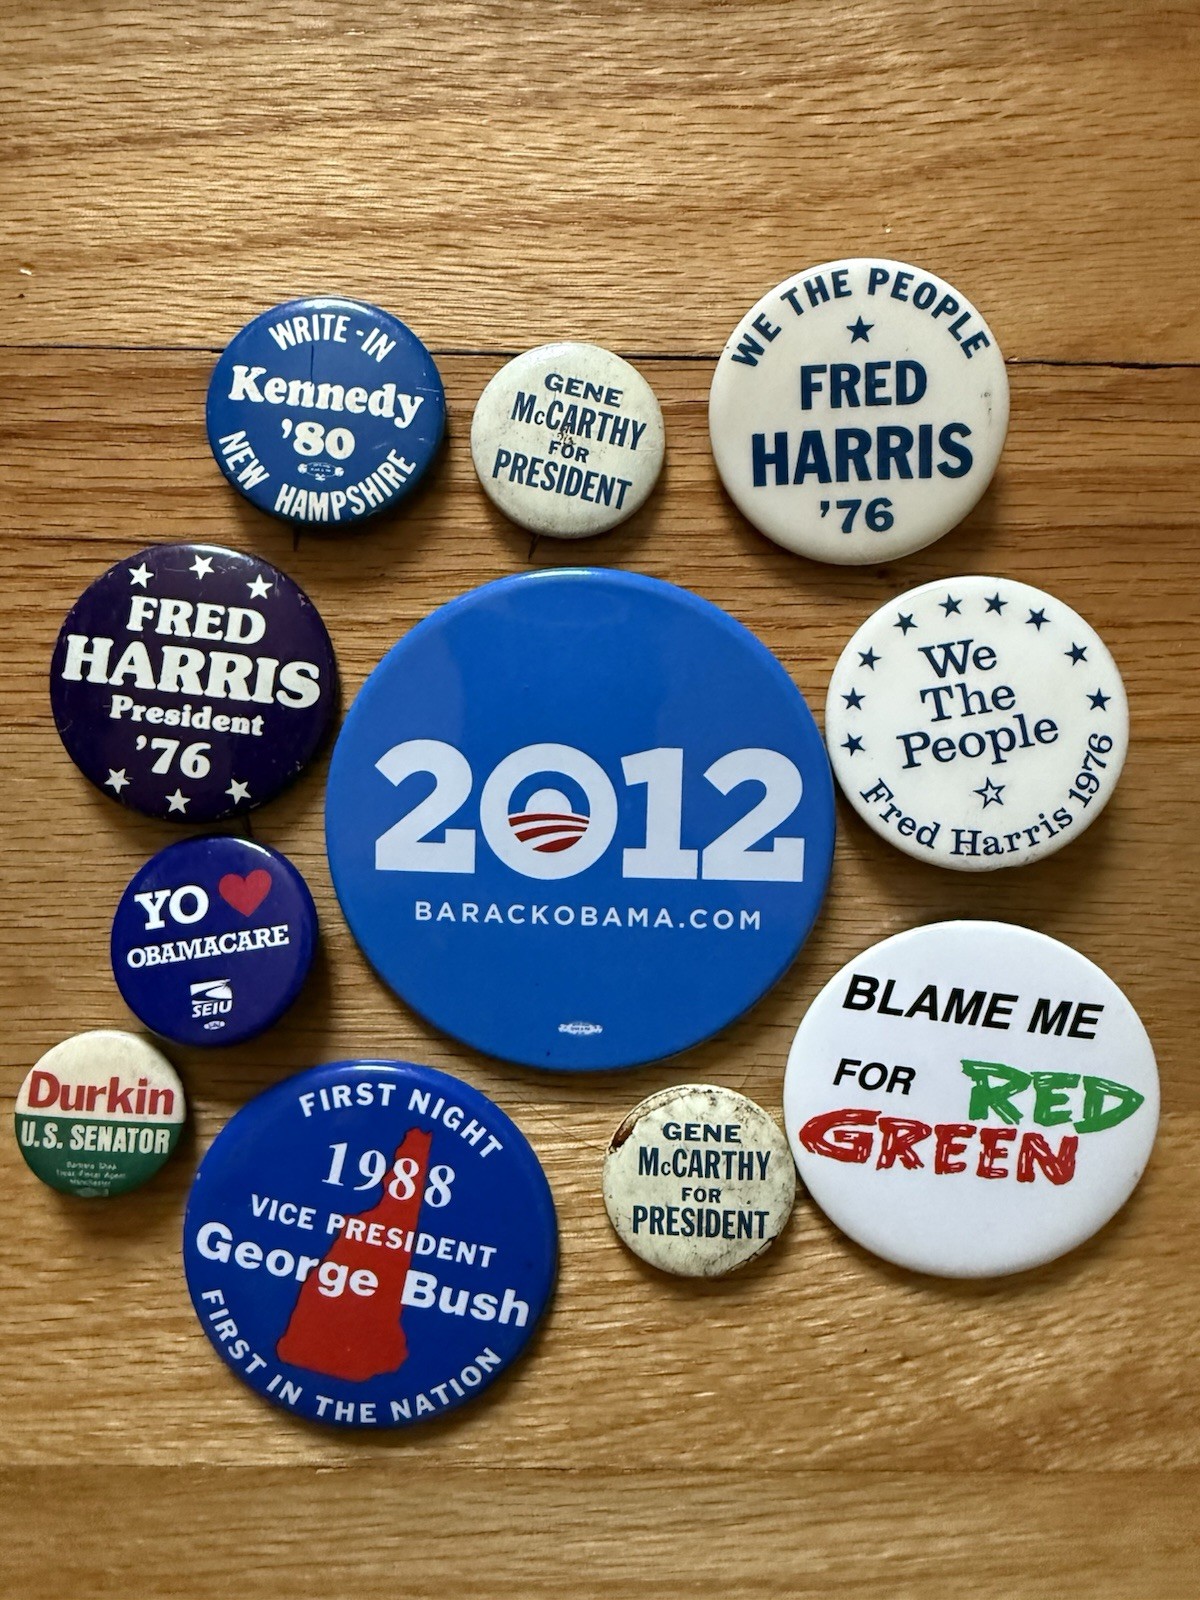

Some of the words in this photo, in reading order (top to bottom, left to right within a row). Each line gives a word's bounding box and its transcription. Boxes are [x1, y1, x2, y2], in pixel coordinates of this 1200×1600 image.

[731, 313, 782, 367] WE
[781, 269, 851, 316] THE
[868, 267, 990, 359] PEOPLE
[228, 364, 424, 429] Kennedy
[545, 373, 624, 408] GENE
[800, 360, 928, 410] FRED
[280, 418, 356, 461] '80
[511, 391, 647, 451] McCARTHY
[219, 430, 270, 491] NEW
[274, 449, 416, 522] HAMPSHIRE
[548, 440, 590, 464] FOR
[752, 422, 973, 487] HARRIS
[492, 449, 633, 510] PRESIDENT
[820, 497, 894, 534] '76
[126, 595, 266, 644] FRED
[61, 634, 321, 709] HARRIS
[917, 639, 997, 679] We
[109, 694, 264, 736] President
[919, 683, 1016, 722] The
[136, 734, 211, 779] '76
[896, 713, 1059, 770] People
[374, 739, 805, 882] 2012
[859, 778, 941, 850] Fred
[950, 806, 1073, 857] Harris
[1068, 733, 1114, 809] 1976
[134, 884, 210, 931] YO
[415, 900, 761, 931] BARACKOBAMA.COM
[126, 924, 290, 969] OBAMACARE
[191, 999, 233, 1018] SEIU
[842, 974, 1018, 1030] BLAME
[1027, 999, 1105, 1040] ME
[27, 1070, 175, 1115] Durkin
[833, 1058, 917, 1095] FOR
[960, 1059, 1146, 1134] RED
[20, 1120, 64, 1150] U.S.
[69, 1124, 171, 1154] SENATOR
[298, 1082, 397, 1118] FIRST
[407, 1088, 503, 1159] NIGHT
[662, 1122, 742, 1144] GENE
[638, 1147, 771, 1182] McCARTHY
[799, 1108, 1079, 1186] GREEN
[321, 1142, 457, 1208] 1988
[681, 1187, 722, 1204] FOR
[251, 1193, 317, 1230] VICE
[326, 1212, 498, 1268] PRESIDENT
[632, 1205, 770, 1240] PRESIDENT
[195, 1221, 379, 1298] George
[400, 1269, 530, 1328] Bush
[201, 1289, 268, 1374] FIRST
[265, 1374, 303, 1406] IN
[315, 1395, 377, 1424] THE
[390, 1347, 502, 1422] NATION
